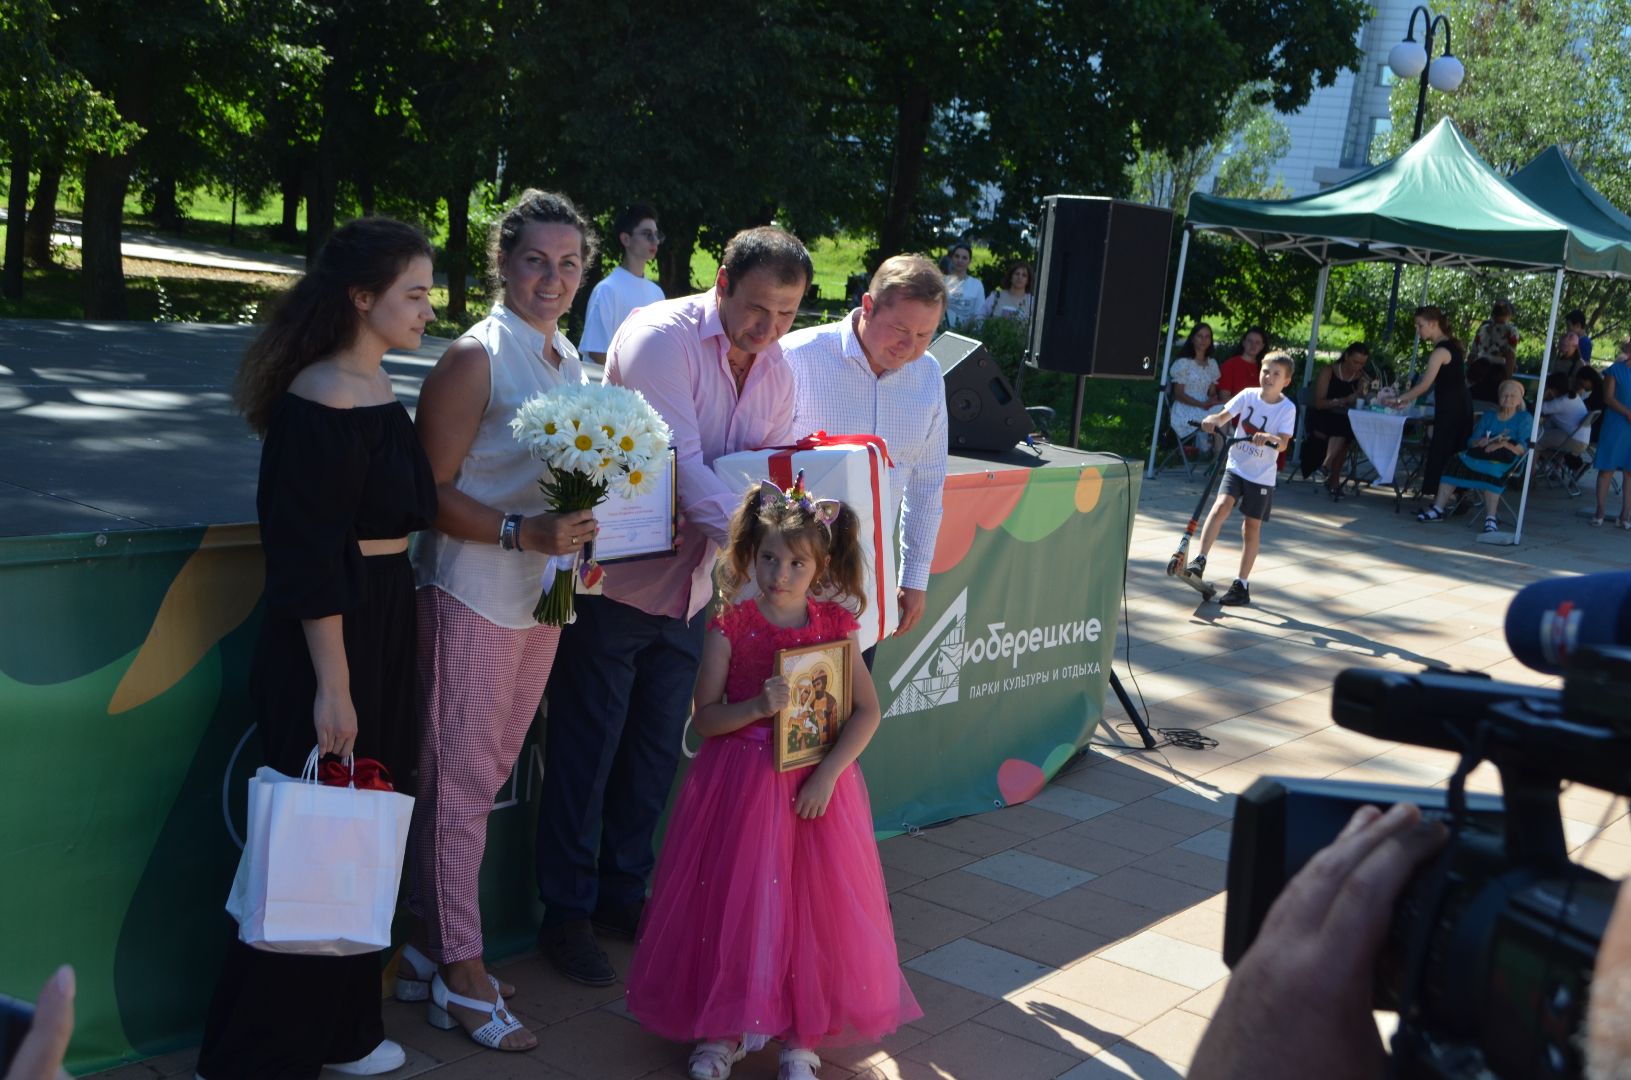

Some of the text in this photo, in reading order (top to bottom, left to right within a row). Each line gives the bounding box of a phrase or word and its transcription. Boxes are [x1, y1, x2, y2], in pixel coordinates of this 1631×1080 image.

[969, 661, 1101, 699] ПАРКИ КУЛЬТУРЫ И ОТДЫХА
